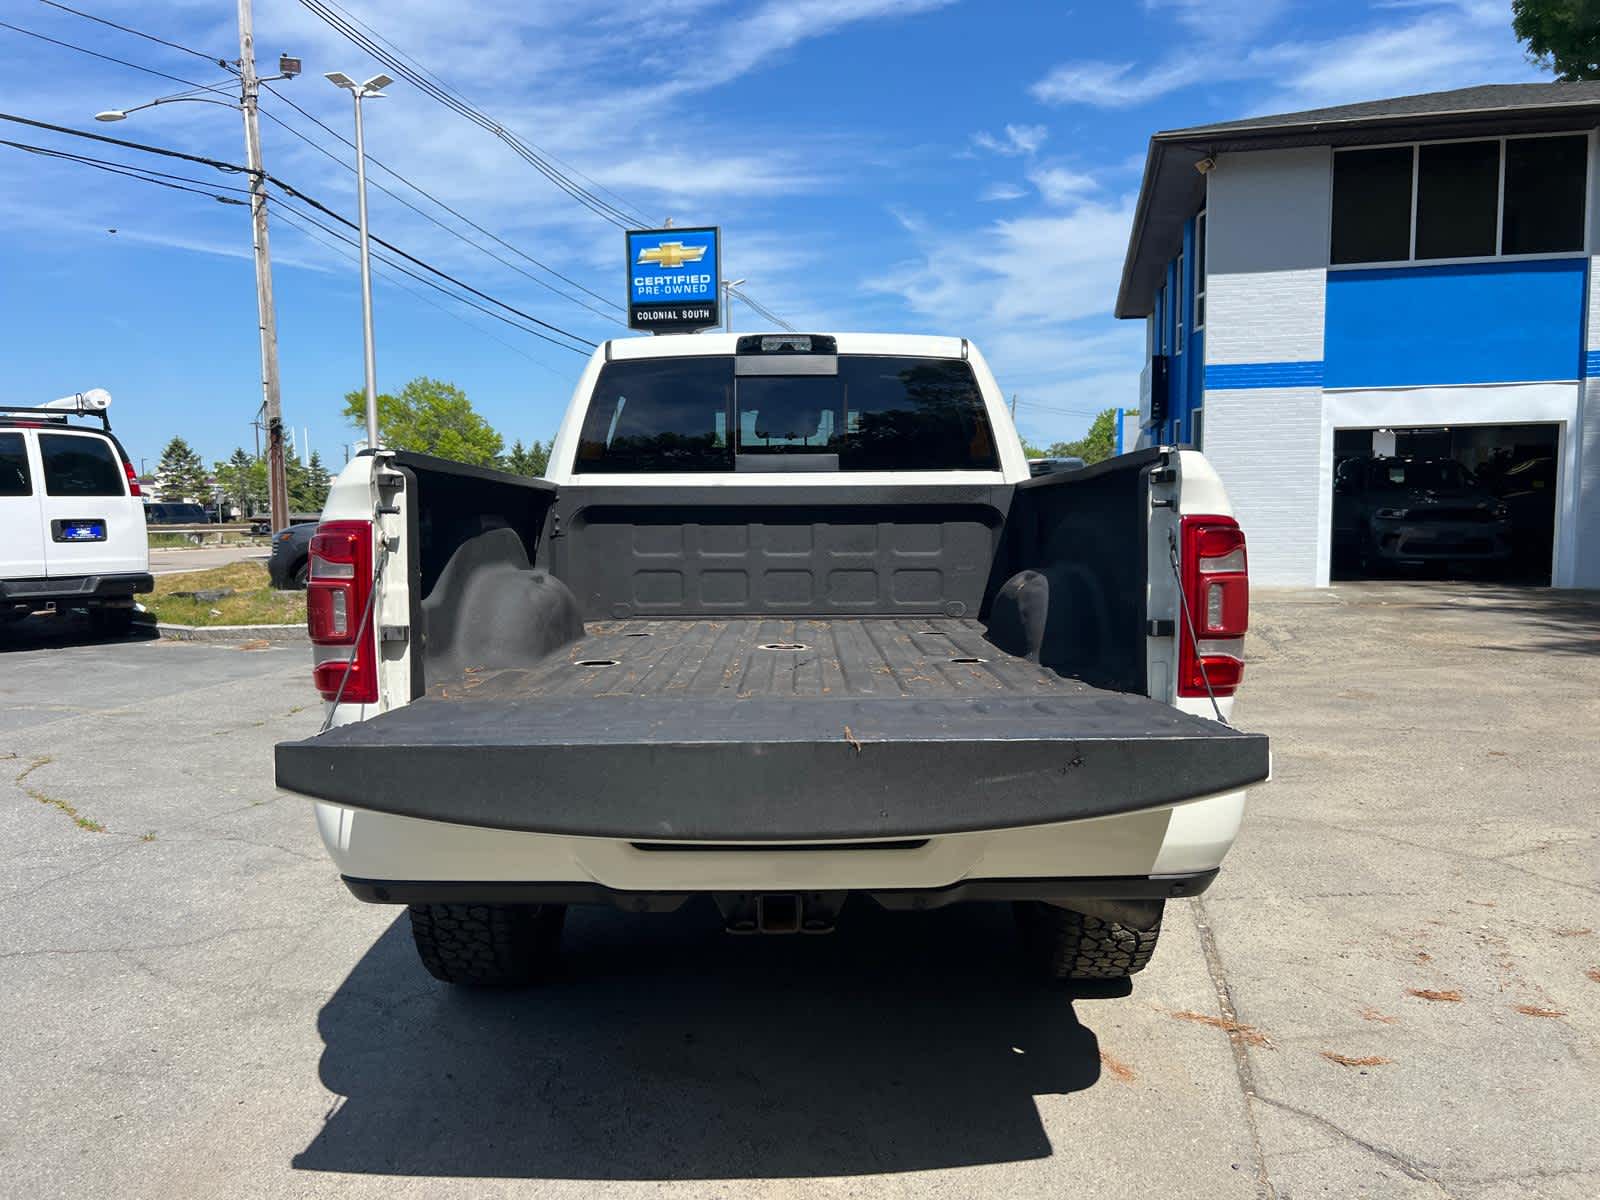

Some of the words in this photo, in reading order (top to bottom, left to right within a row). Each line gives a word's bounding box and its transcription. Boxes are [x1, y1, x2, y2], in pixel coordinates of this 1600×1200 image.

[634, 274, 711, 286] CERTIFIED
[638, 284, 707, 295] PRE-OWNED
[637, 311, 678, 320] COLONIAL
[682, 310, 710, 319] SOUTH
